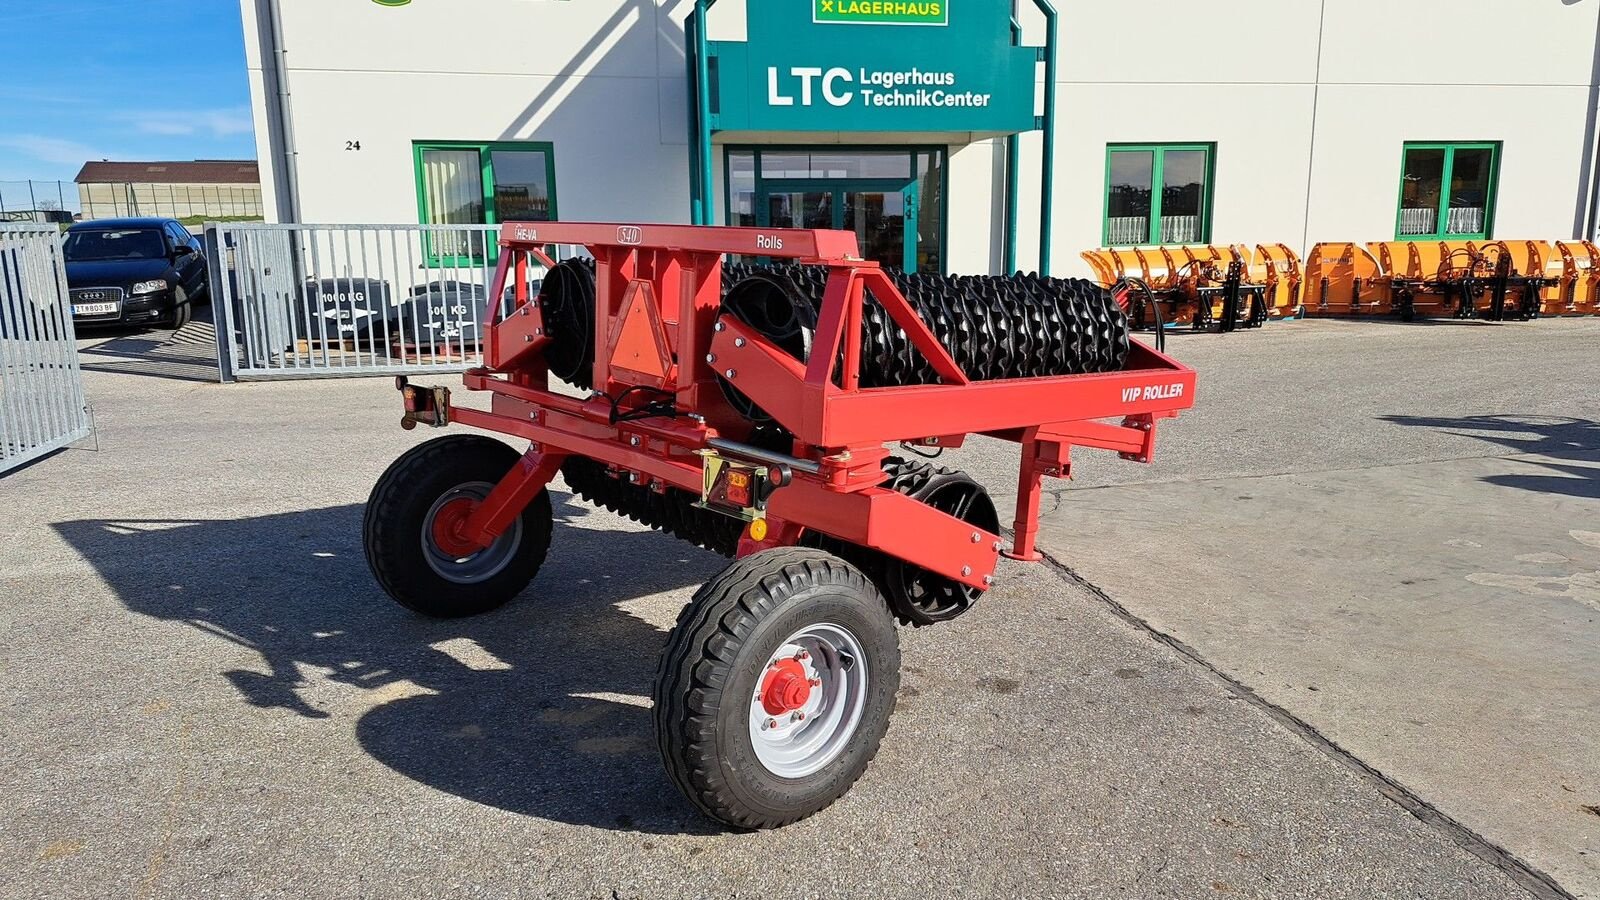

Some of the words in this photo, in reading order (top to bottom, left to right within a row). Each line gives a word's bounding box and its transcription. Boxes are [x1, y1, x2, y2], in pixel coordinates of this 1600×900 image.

[838, 1, 940, 15] LAGERHAUS
[860, 67, 955, 88] Lagerhaus
[767, 66, 853, 107] LTC
[860, 89, 991, 107] TechnikCenter
[345, 140, 361, 151] 24
[515, 228, 537, 240] HE-VA
[620, 227, 637, 243] 540
[757, 234, 783, 249] Rolls
[1122, 387, 1141, 402] VIP
[1142, 383, 1184, 400] ROLLER
